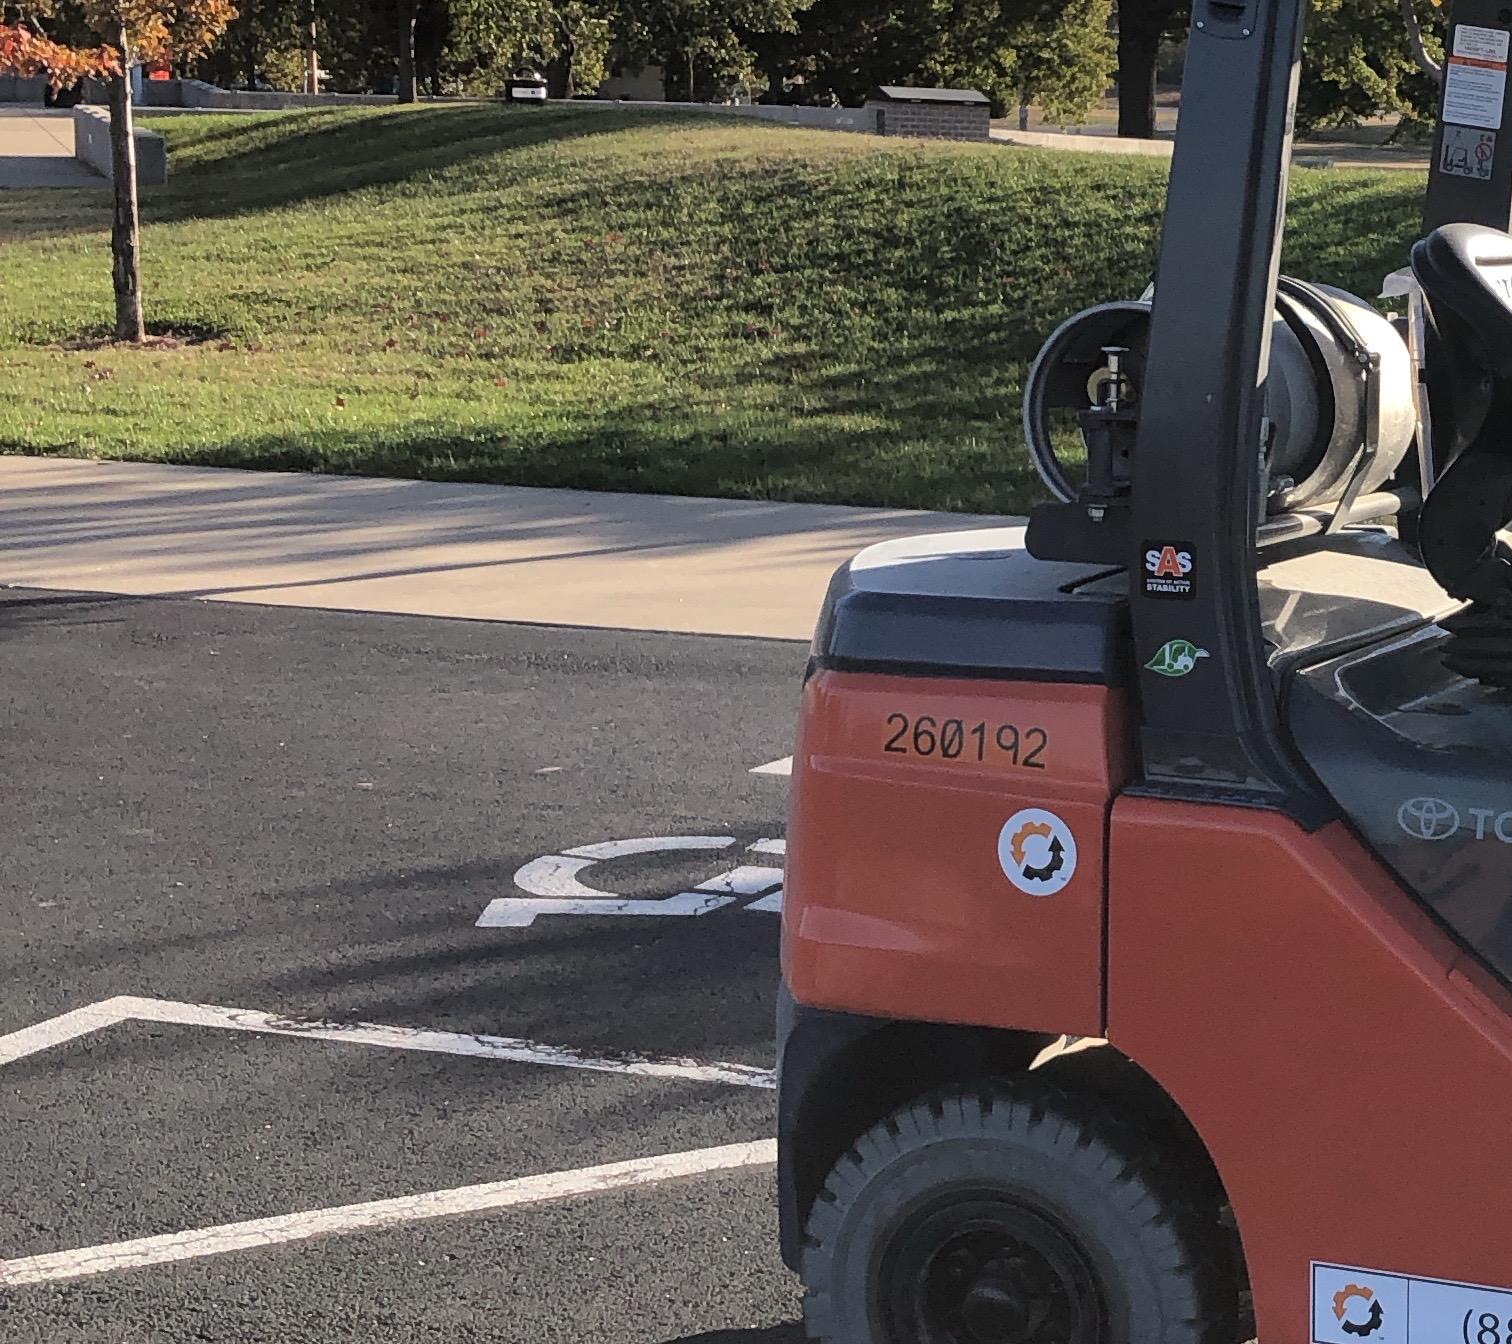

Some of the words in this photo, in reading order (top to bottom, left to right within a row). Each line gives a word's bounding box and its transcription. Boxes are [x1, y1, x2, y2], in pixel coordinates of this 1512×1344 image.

[1145, 546, 1193, 577] SAS
[1146, 584, 1191, 593] STABILITY
[884, 713, 1047, 769] 260192
